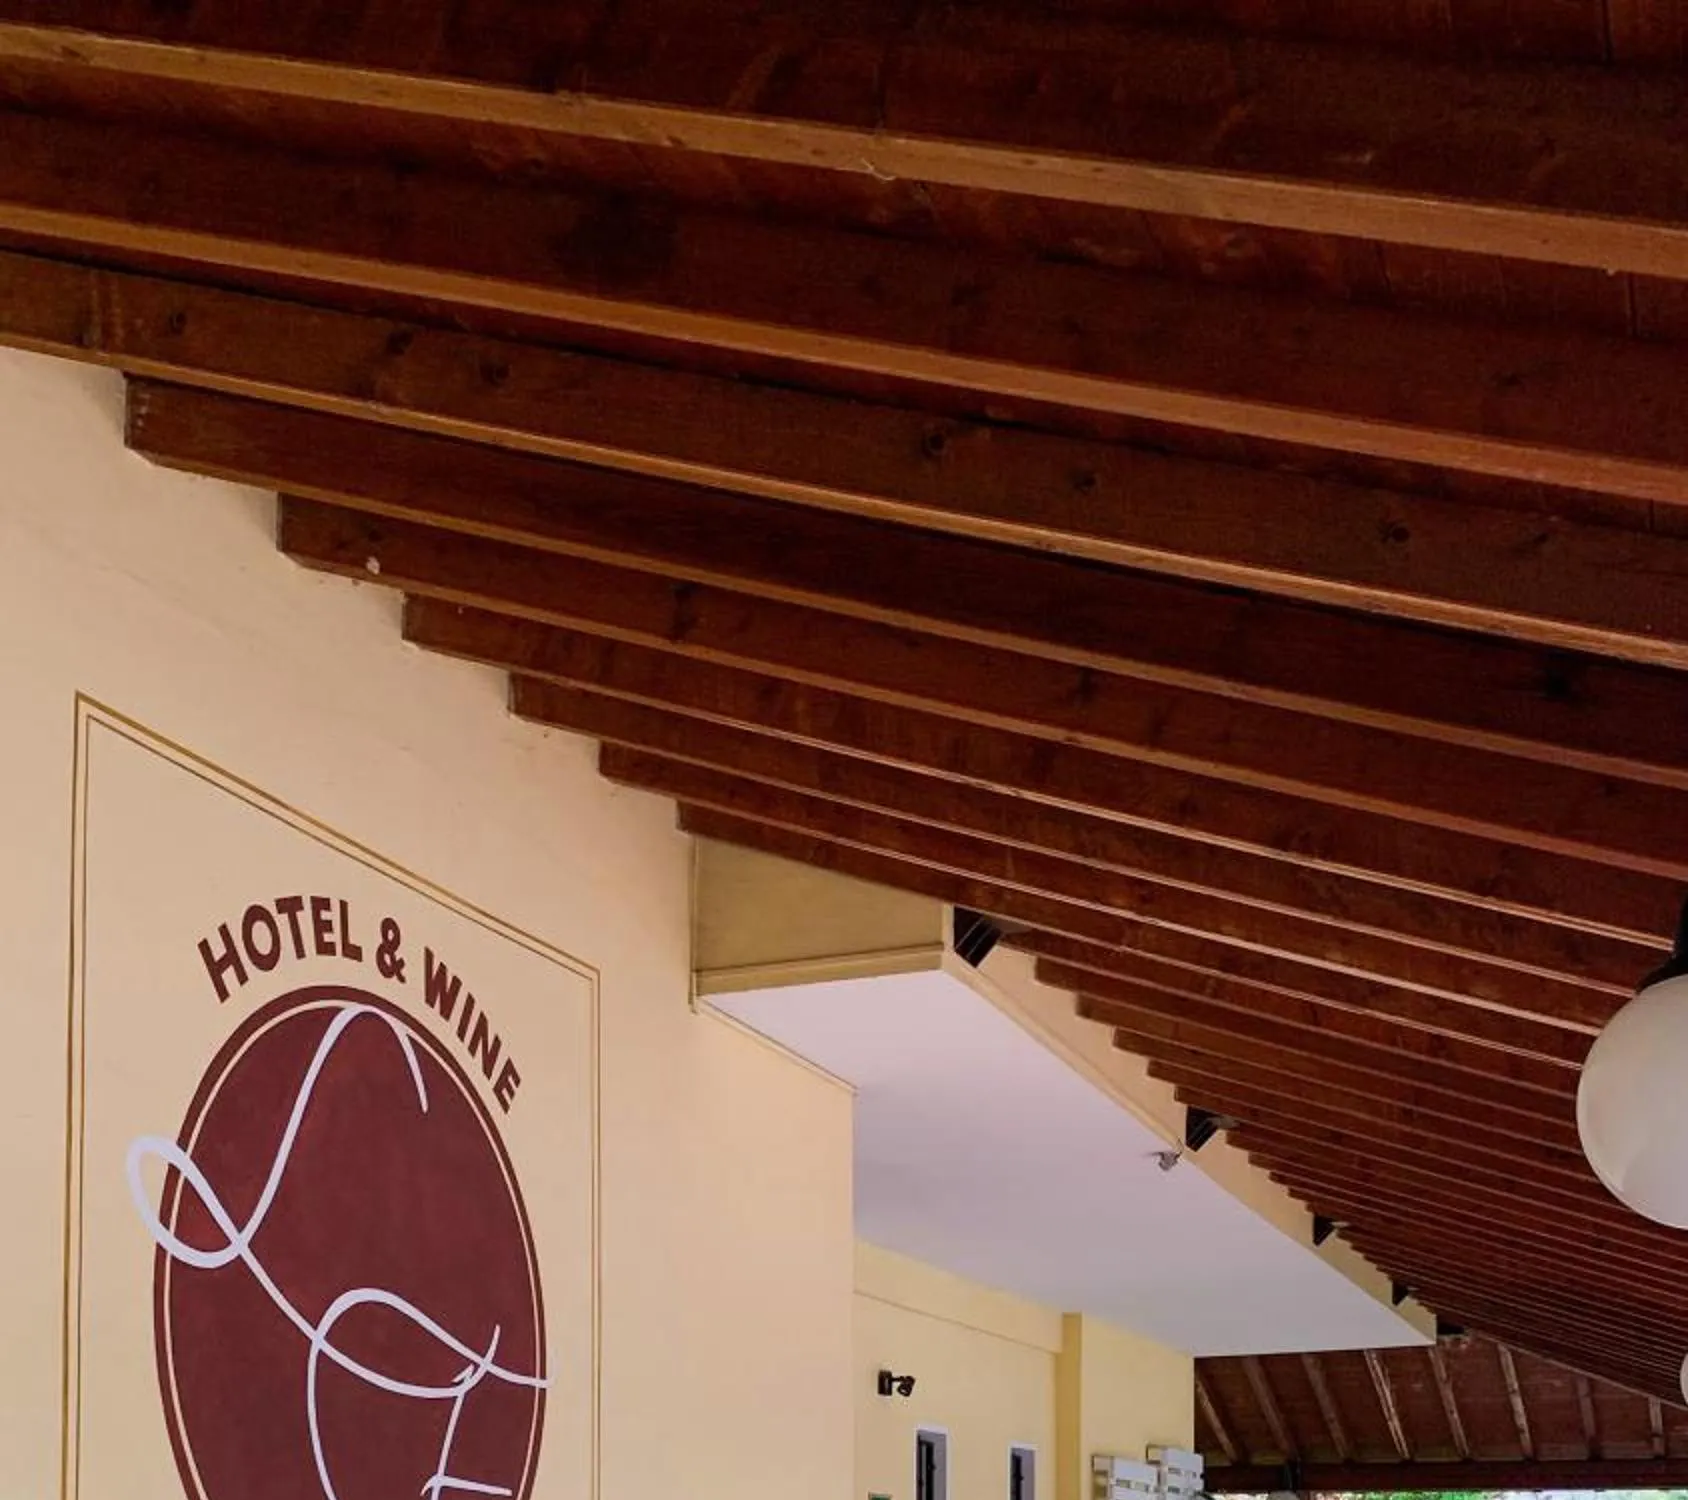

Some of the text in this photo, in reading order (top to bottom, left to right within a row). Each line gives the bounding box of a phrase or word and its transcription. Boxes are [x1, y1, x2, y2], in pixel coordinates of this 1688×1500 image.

[197, 895, 522, 1114] HOTEL & WINE
